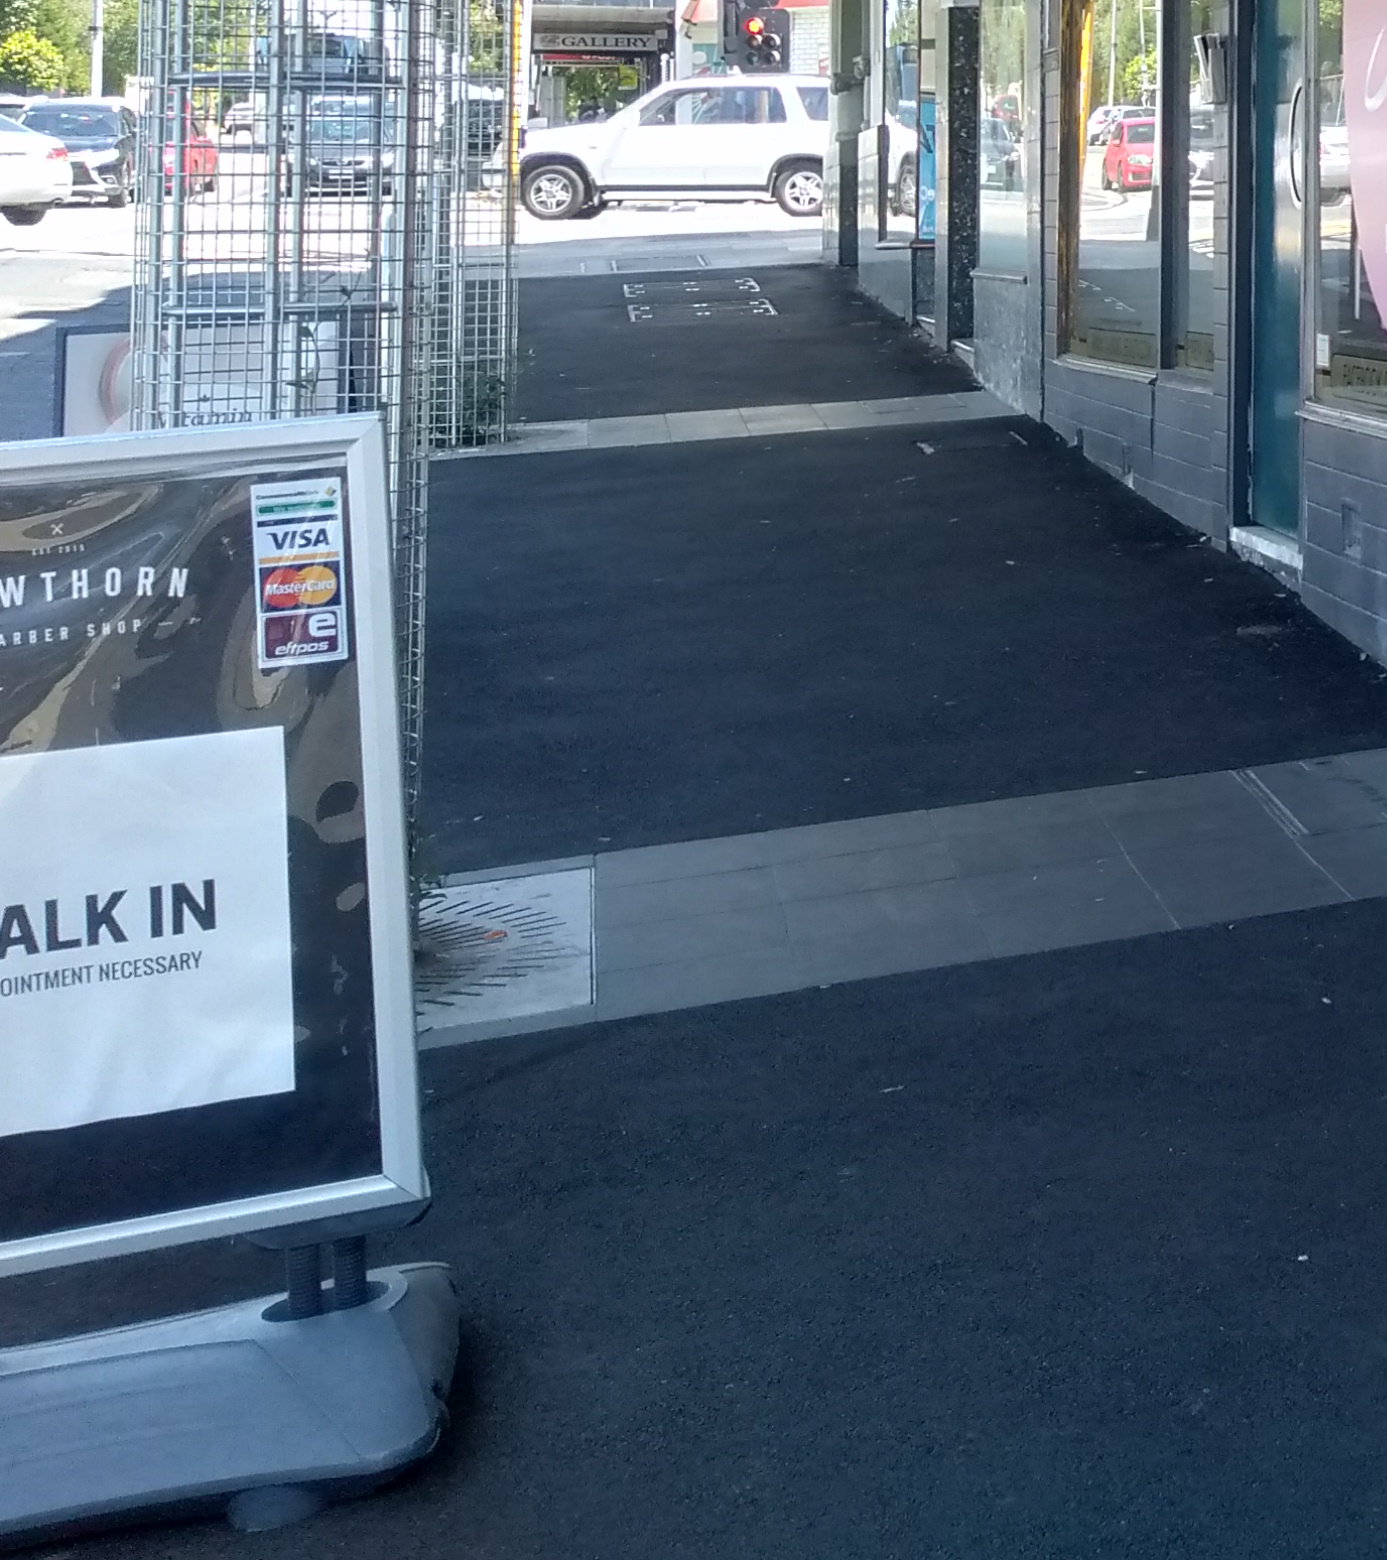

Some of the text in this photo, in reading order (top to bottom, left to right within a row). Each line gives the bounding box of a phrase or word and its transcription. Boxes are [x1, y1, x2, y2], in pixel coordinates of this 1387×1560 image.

[561, 35, 651, 48] GALLERY
[157, 406, 253, 428] Vtamin
[266, 528, 331, 550] VISA
[265, 579, 335, 597] MasterCard
[87, 619, 142, 638] SHOP
[308, 612, 337, 638] e
[275, 640, 330, 657] eftpos
[149, 878, 217, 939] IN
[98, 950, 203, 983] NECESSARY
